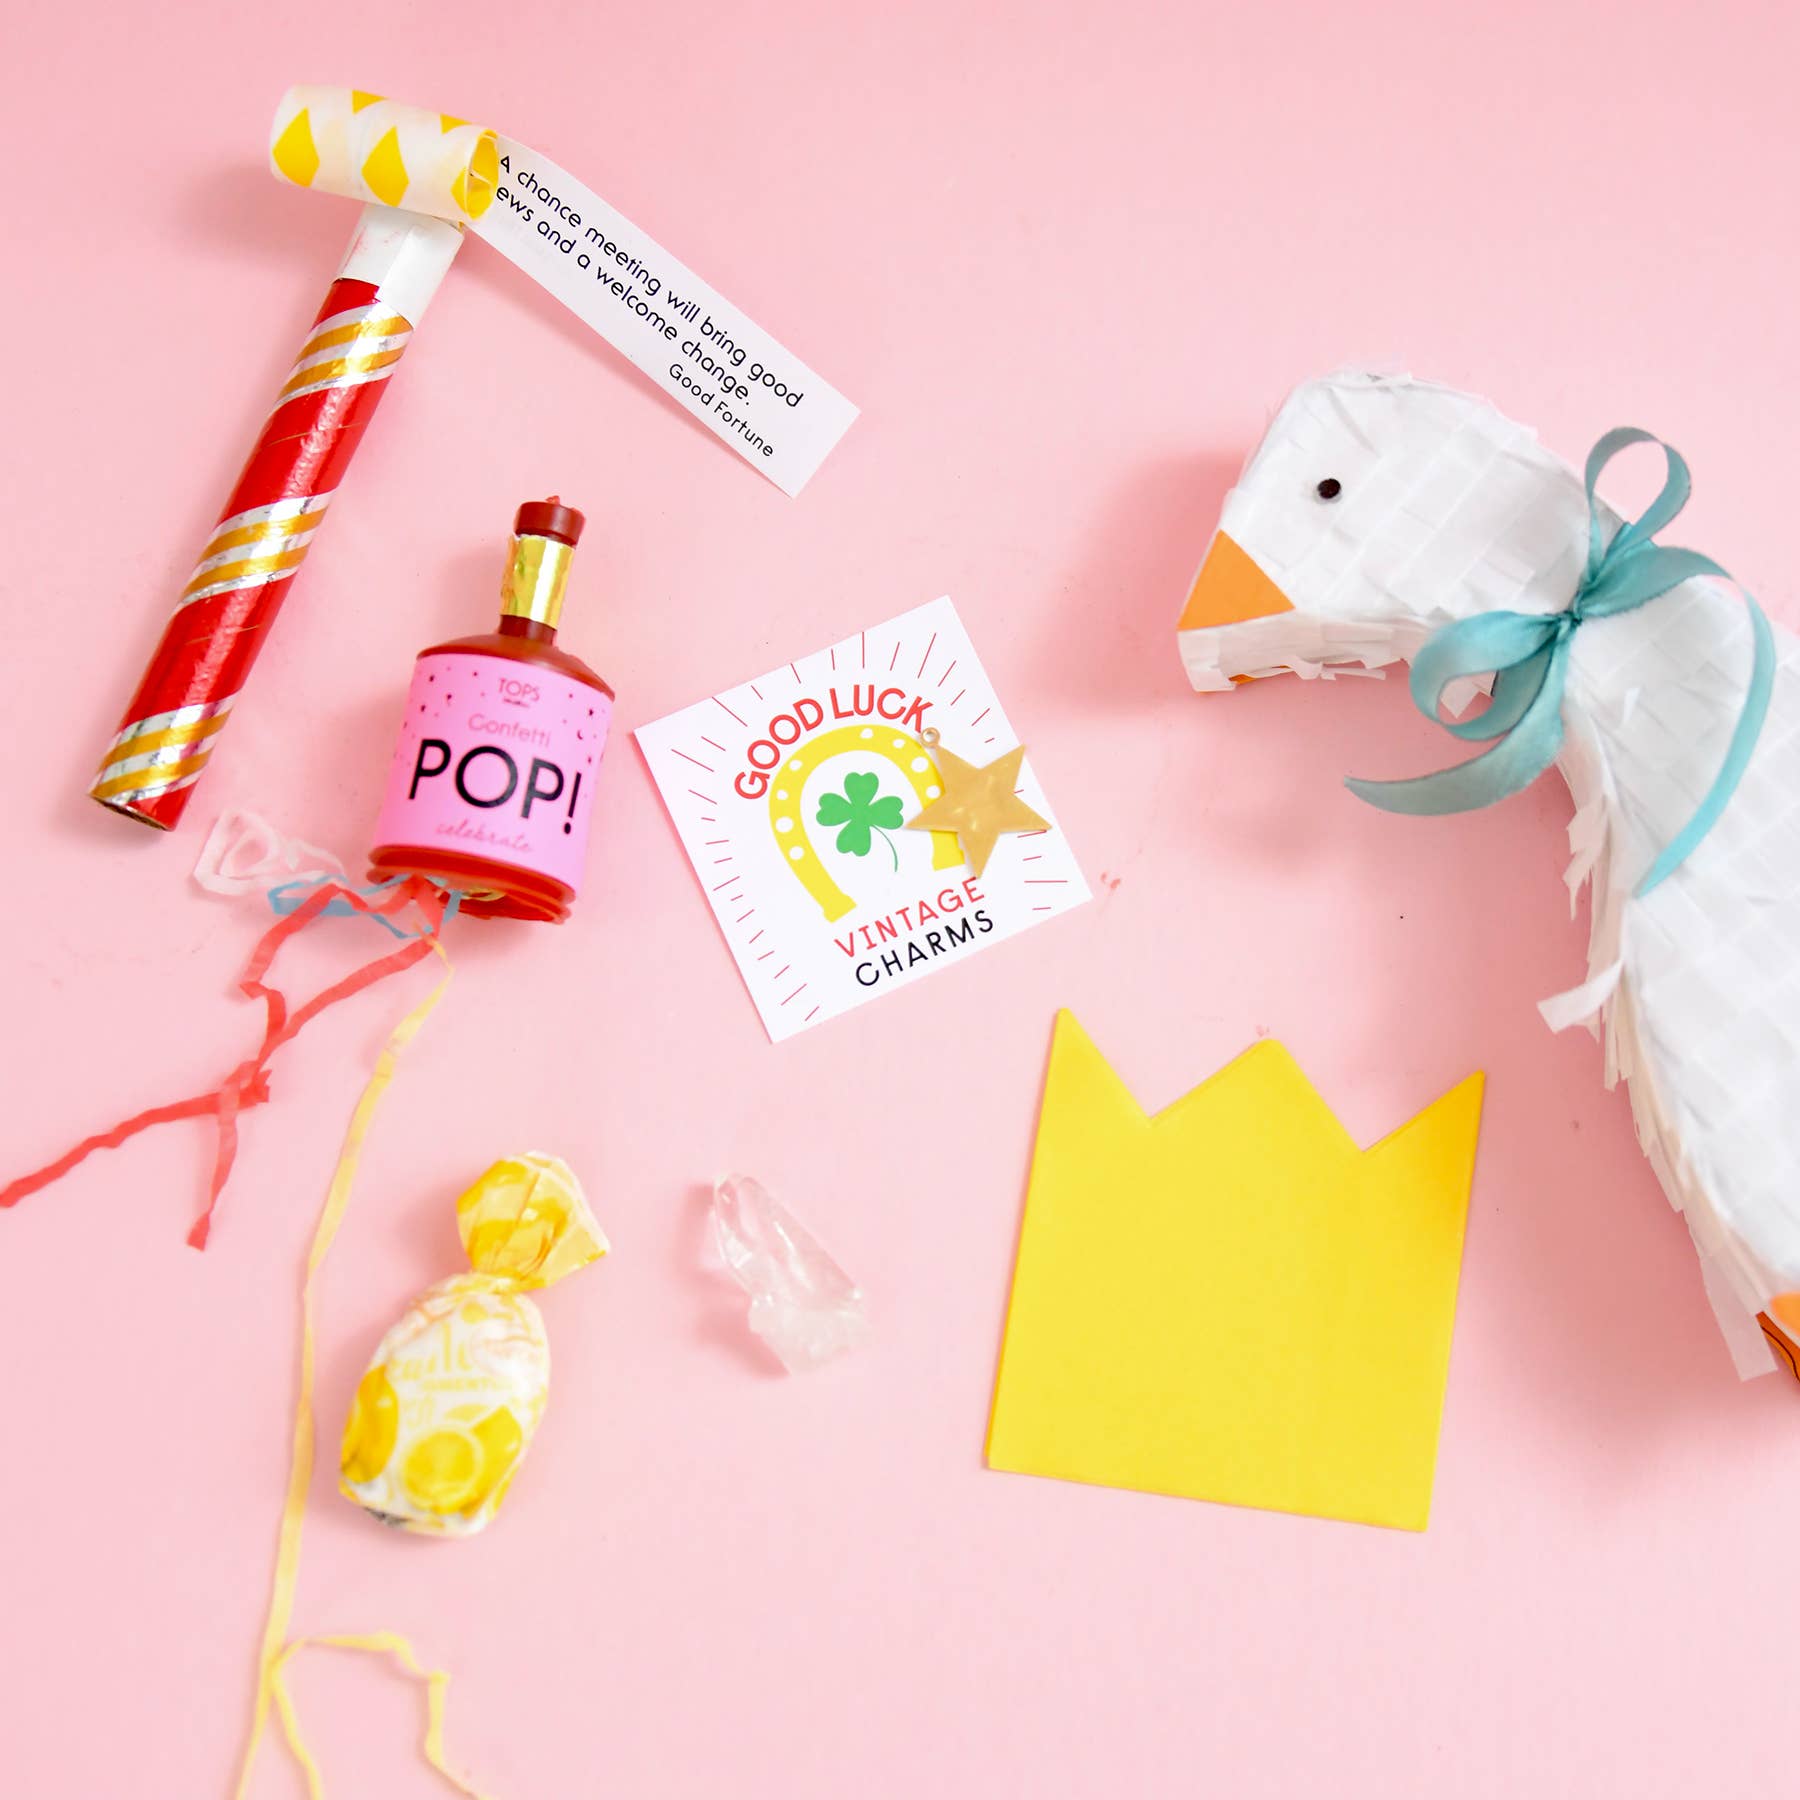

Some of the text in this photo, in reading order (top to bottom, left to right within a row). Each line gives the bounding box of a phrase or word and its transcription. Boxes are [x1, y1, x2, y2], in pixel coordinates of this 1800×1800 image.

[496, 186, 750, 406] ews and a welcome change.
[500, 155, 804, 408] A chance meeting will bring good
[669, 363, 774, 457] Good Fortune
[468, 713, 551, 748] Confetti
[499, 678, 540, 702] TOPS
[734, 684, 934, 800] GOOD LUCK
[408, 738, 583, 836] POP!
[435, 819, 534, 852] celebrate
[834, 876, 986, 959] VINTAGE
[854, 909, 995, 987] CHARMS
